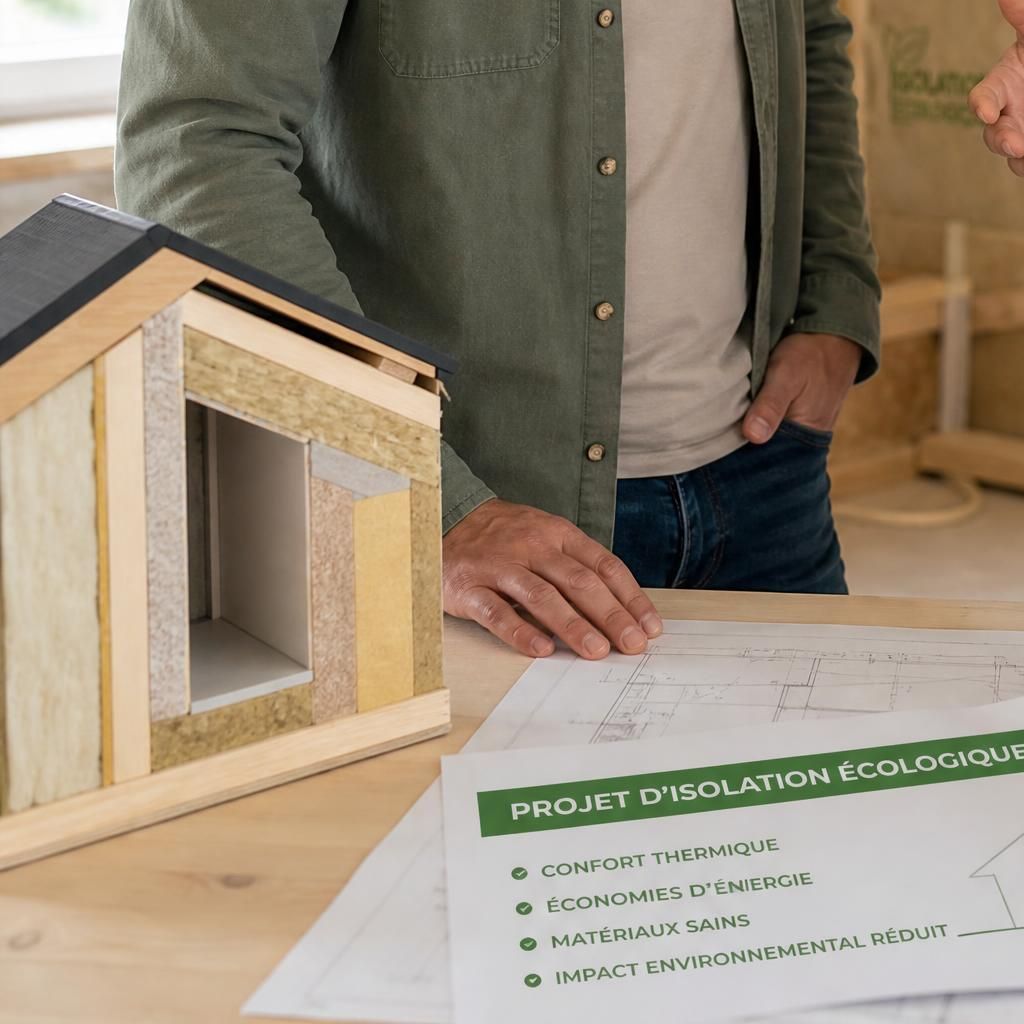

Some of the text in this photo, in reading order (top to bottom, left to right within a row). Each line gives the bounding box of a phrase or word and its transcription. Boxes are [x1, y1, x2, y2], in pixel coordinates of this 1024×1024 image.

[510, 789, 631, 821] PROJET
[639, 767, 832, 807] D’ISOLATION
[541, 838, 781, 877] CONFORT THERMIQUE
[546, 886, 684, 914] ÉCONOMIES
[551, 913, 751, 949] MATÉRIAUX SAINS
[555, 923, 949, 985] IMPACT ENVIRONNEMENTAL RÉDUIT
